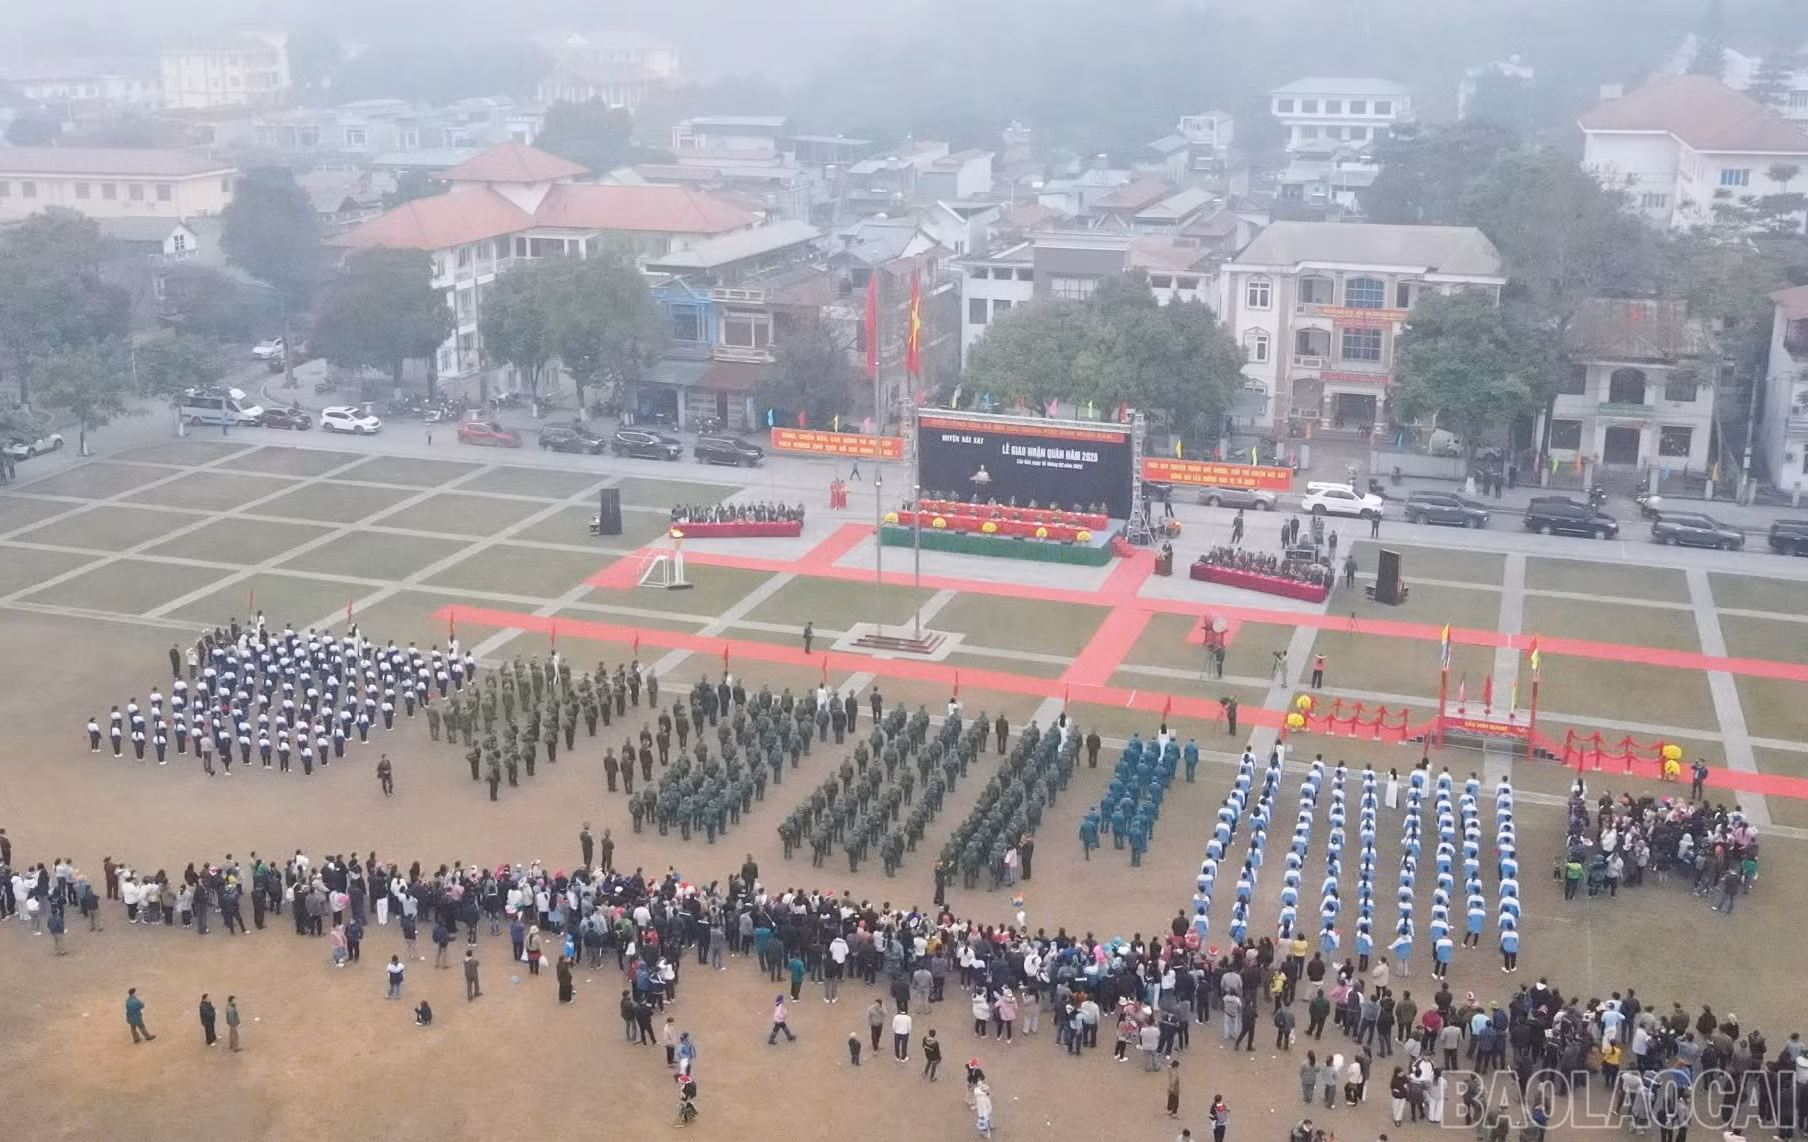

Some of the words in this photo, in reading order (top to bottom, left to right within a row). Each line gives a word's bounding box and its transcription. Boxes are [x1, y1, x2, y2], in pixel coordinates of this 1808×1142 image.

[1002, 442, 1010, 455] LỄ
[1011, 445, 1026, 456] GIAO
[1027, 446, 1046, 459] NHẬN
[1047, 448, 1065, 460] QUÂN
[1065, 449, 1081, 461] NĂM
[1082, 452, 1098, 463] 2025
